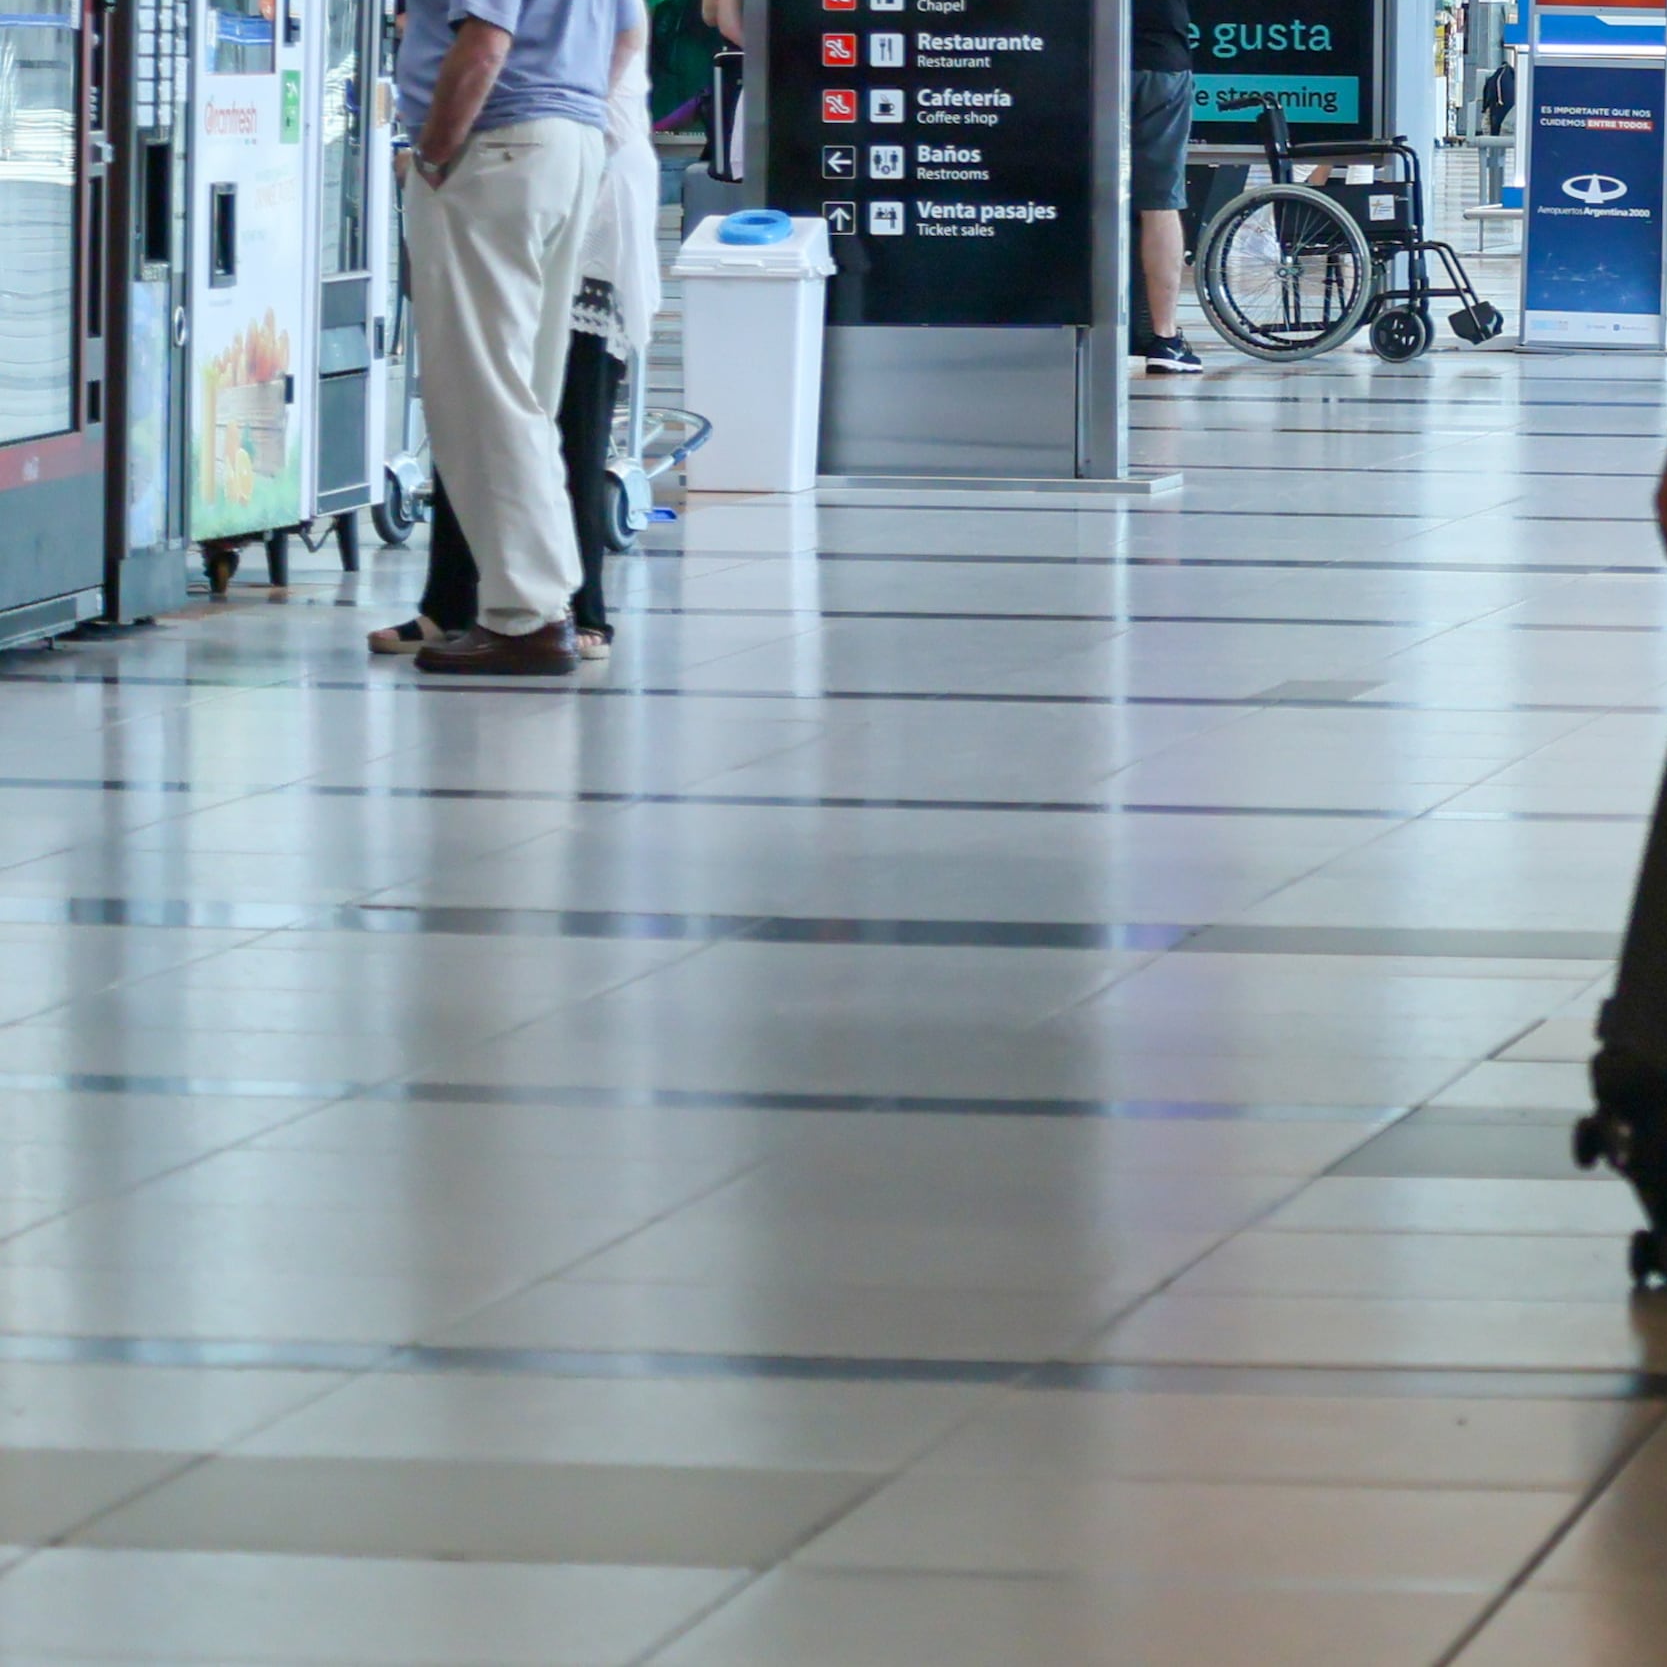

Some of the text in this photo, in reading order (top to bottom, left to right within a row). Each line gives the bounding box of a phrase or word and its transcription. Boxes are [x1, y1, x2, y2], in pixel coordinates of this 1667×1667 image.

[917, 0, 965, 13] Chapel
[917, 34, 1043, 51] Restaurante
[1213, 19, 1332, 58] gusta
[917, 56, 990, 68] Restaurant
[917, 89, 1011, 107] Cafetería
[917, 111, 998, 126] Coffee shop
[1541, 106, 1552, 114] ES
[1554, 106, 1609, 116] IMPORTANTE
[1611, 108, 1630, 117] QUE
[1540, 118, 1651, 129] CUIDEMOS ENTRE TODOS.
[917, 145, 981, 163] Baños
[917, 168, 989, 180] Restrooms
[917, 201, 1057, 223] Venta pasajes
[917, 223, 994, 236] Ticket sales
